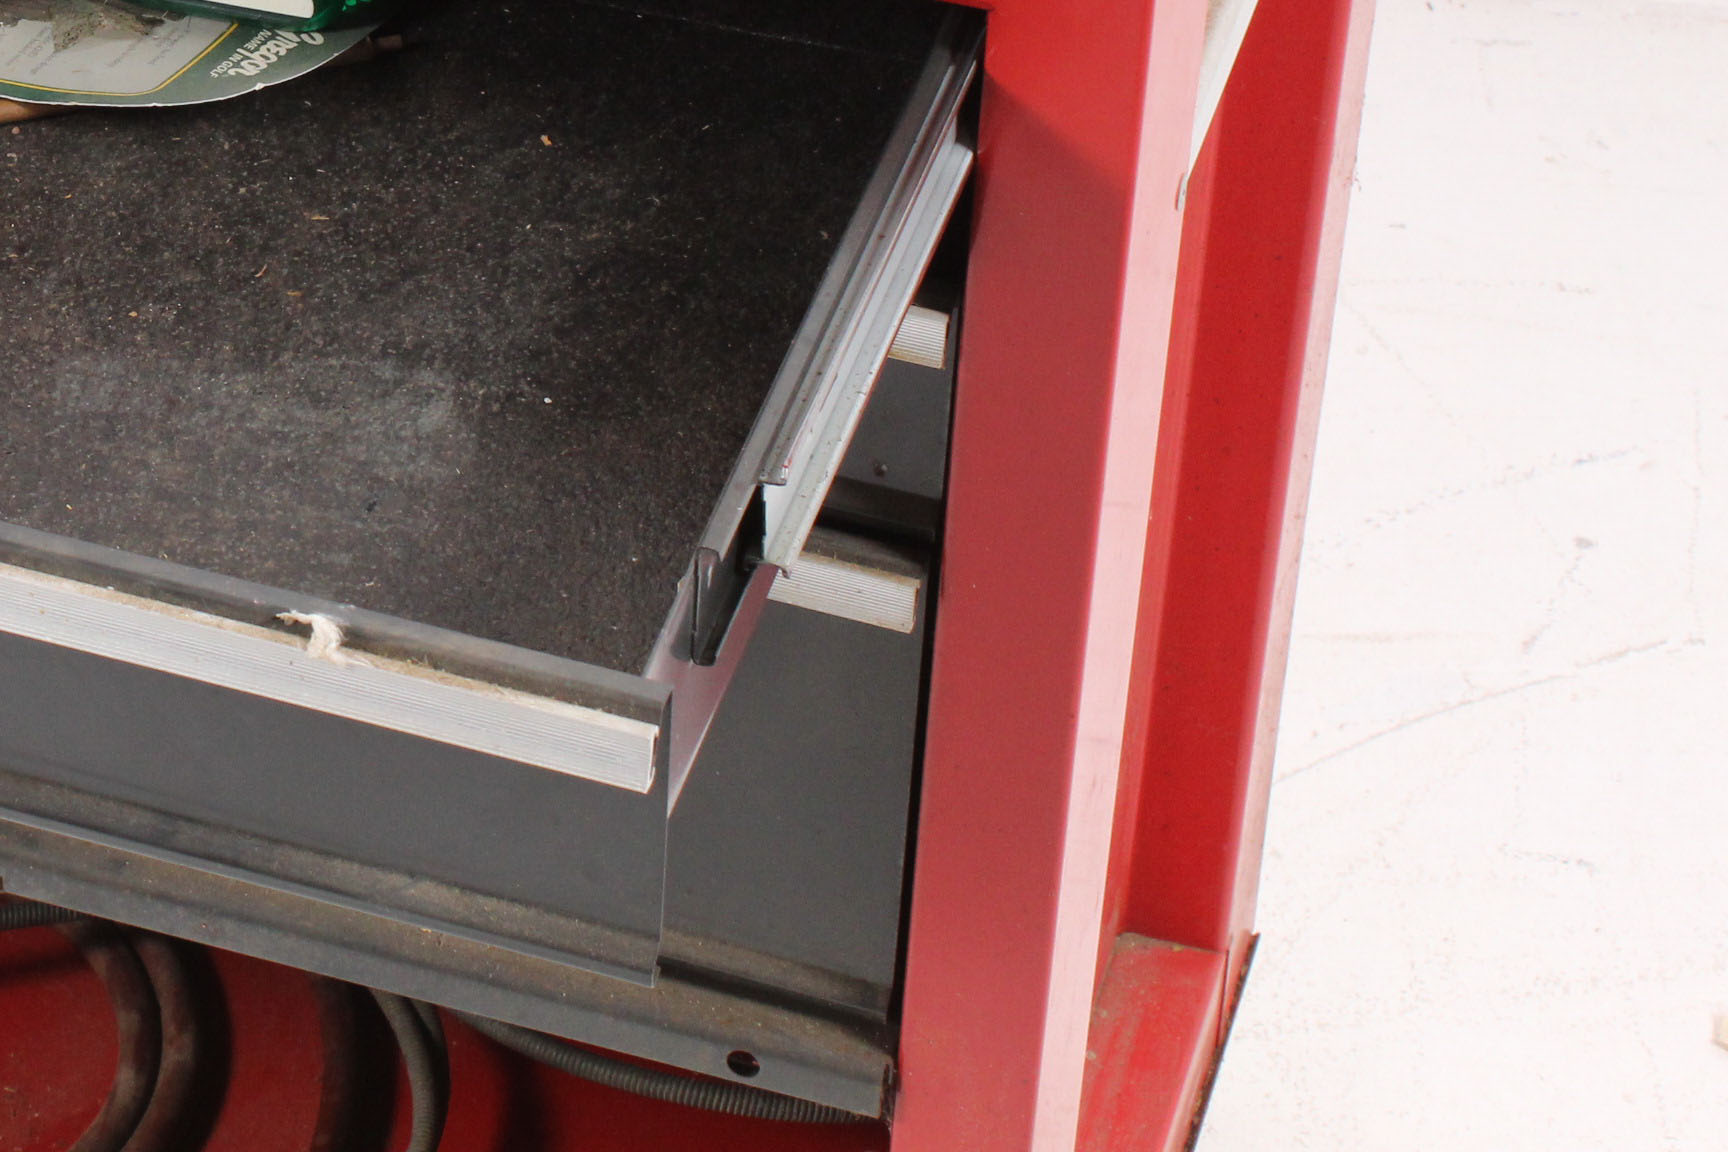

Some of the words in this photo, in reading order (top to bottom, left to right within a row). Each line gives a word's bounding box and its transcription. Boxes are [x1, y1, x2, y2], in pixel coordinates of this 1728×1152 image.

[243, 28, 272, 51] NAME
[228, 52, 244, 63] IN
[209, 60, 234, 79] GOLF
